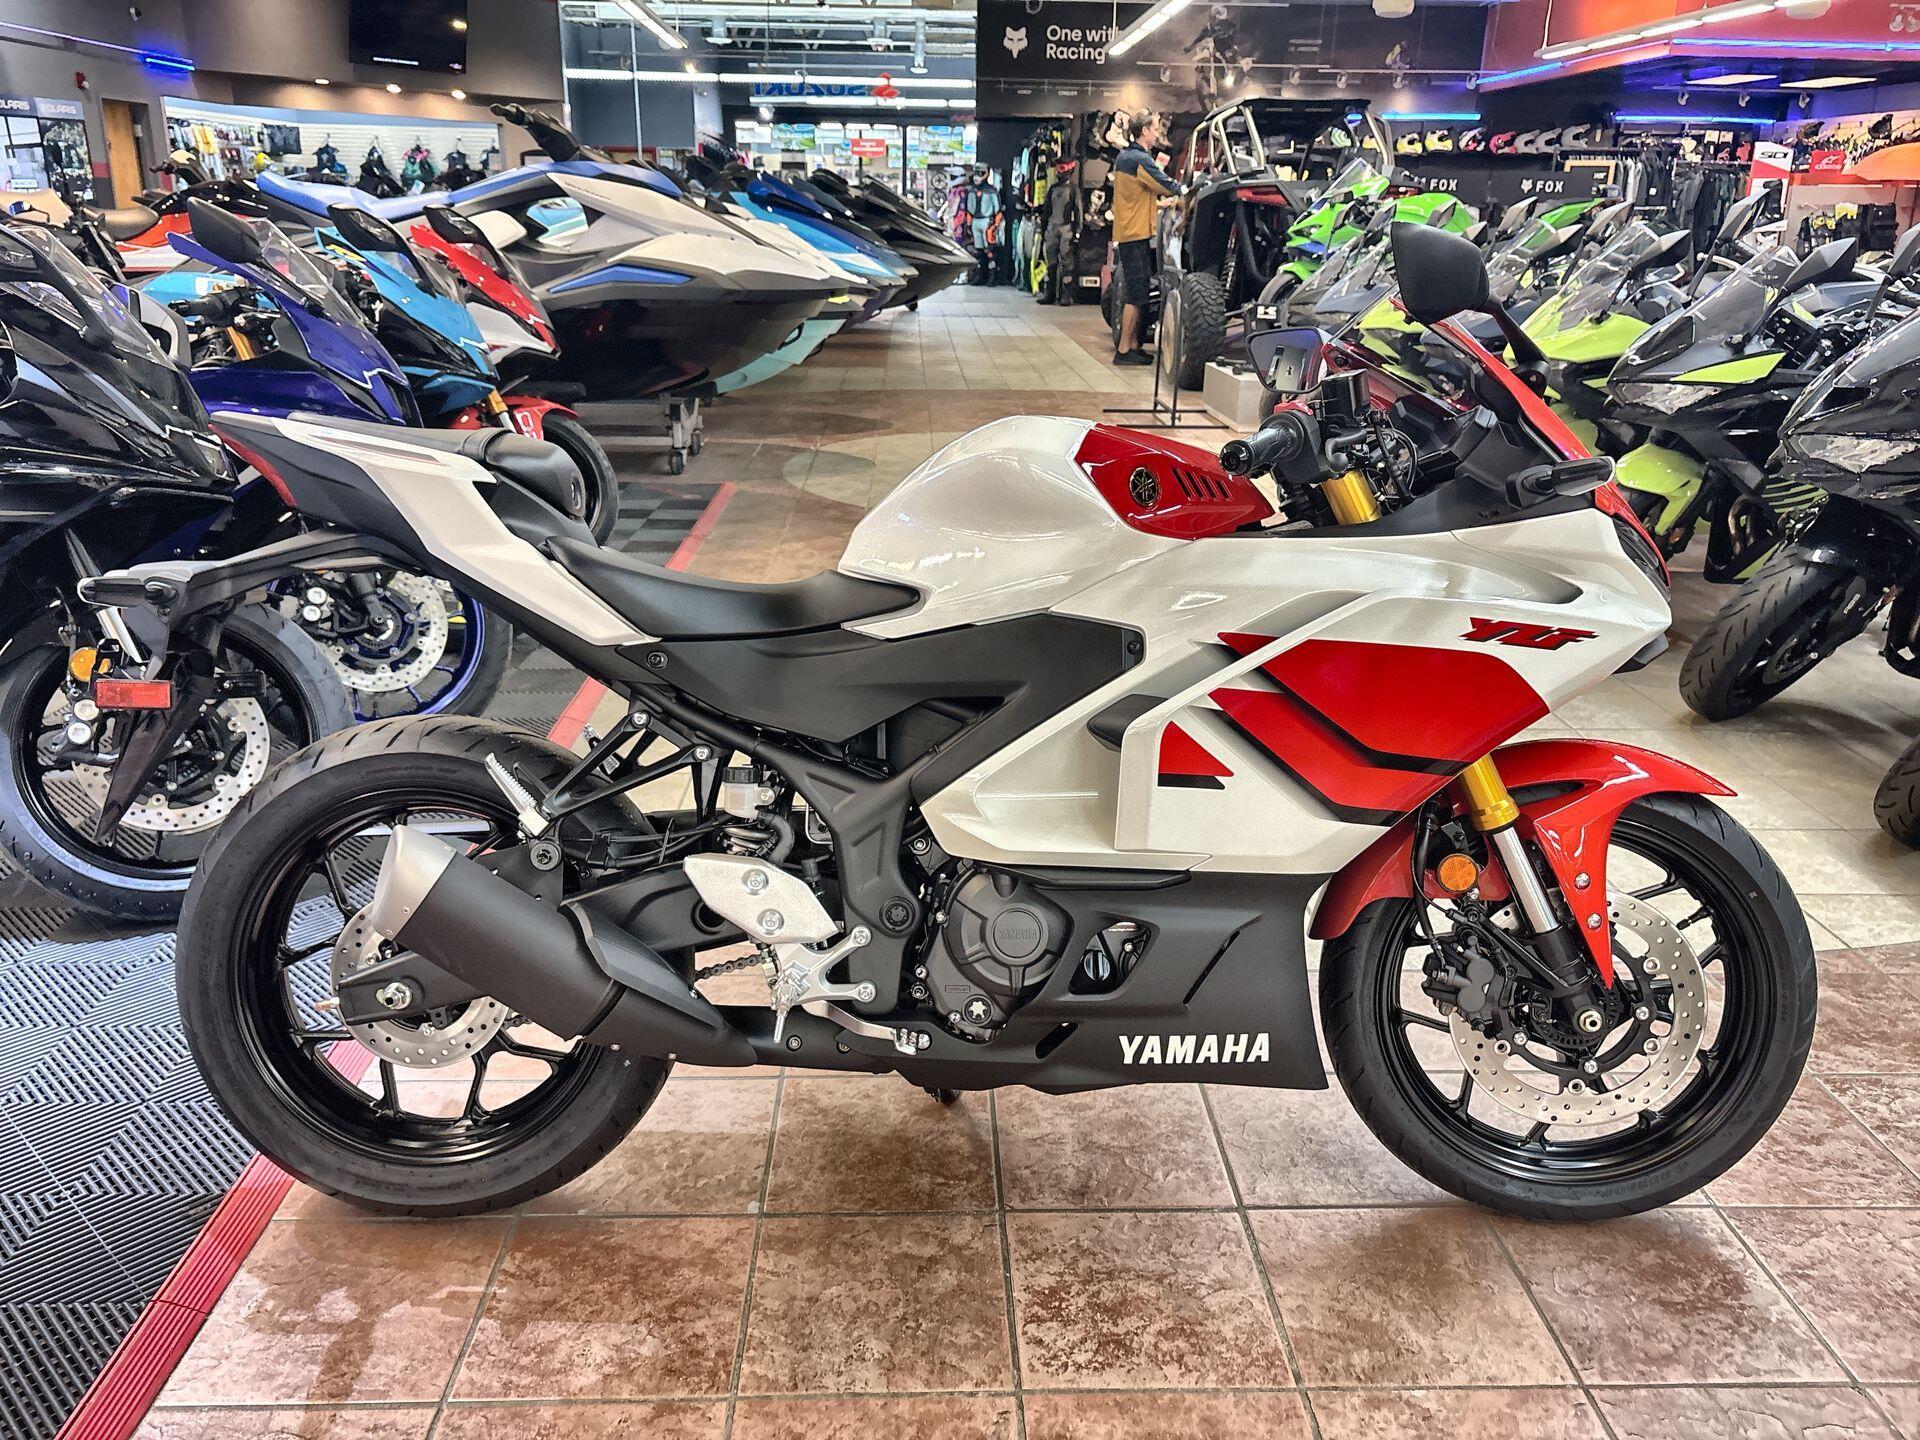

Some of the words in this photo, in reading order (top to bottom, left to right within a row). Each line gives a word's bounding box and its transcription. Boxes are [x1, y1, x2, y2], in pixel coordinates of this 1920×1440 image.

[1046, 24, 1082, 42] One
[1046, 43, 1106, 65] Racing
[1429, 178, 1458, 192] FOX
[1535, 180, 1564, 193] FOX
[1118, 1032, 1270, 1064] YAMAHA
